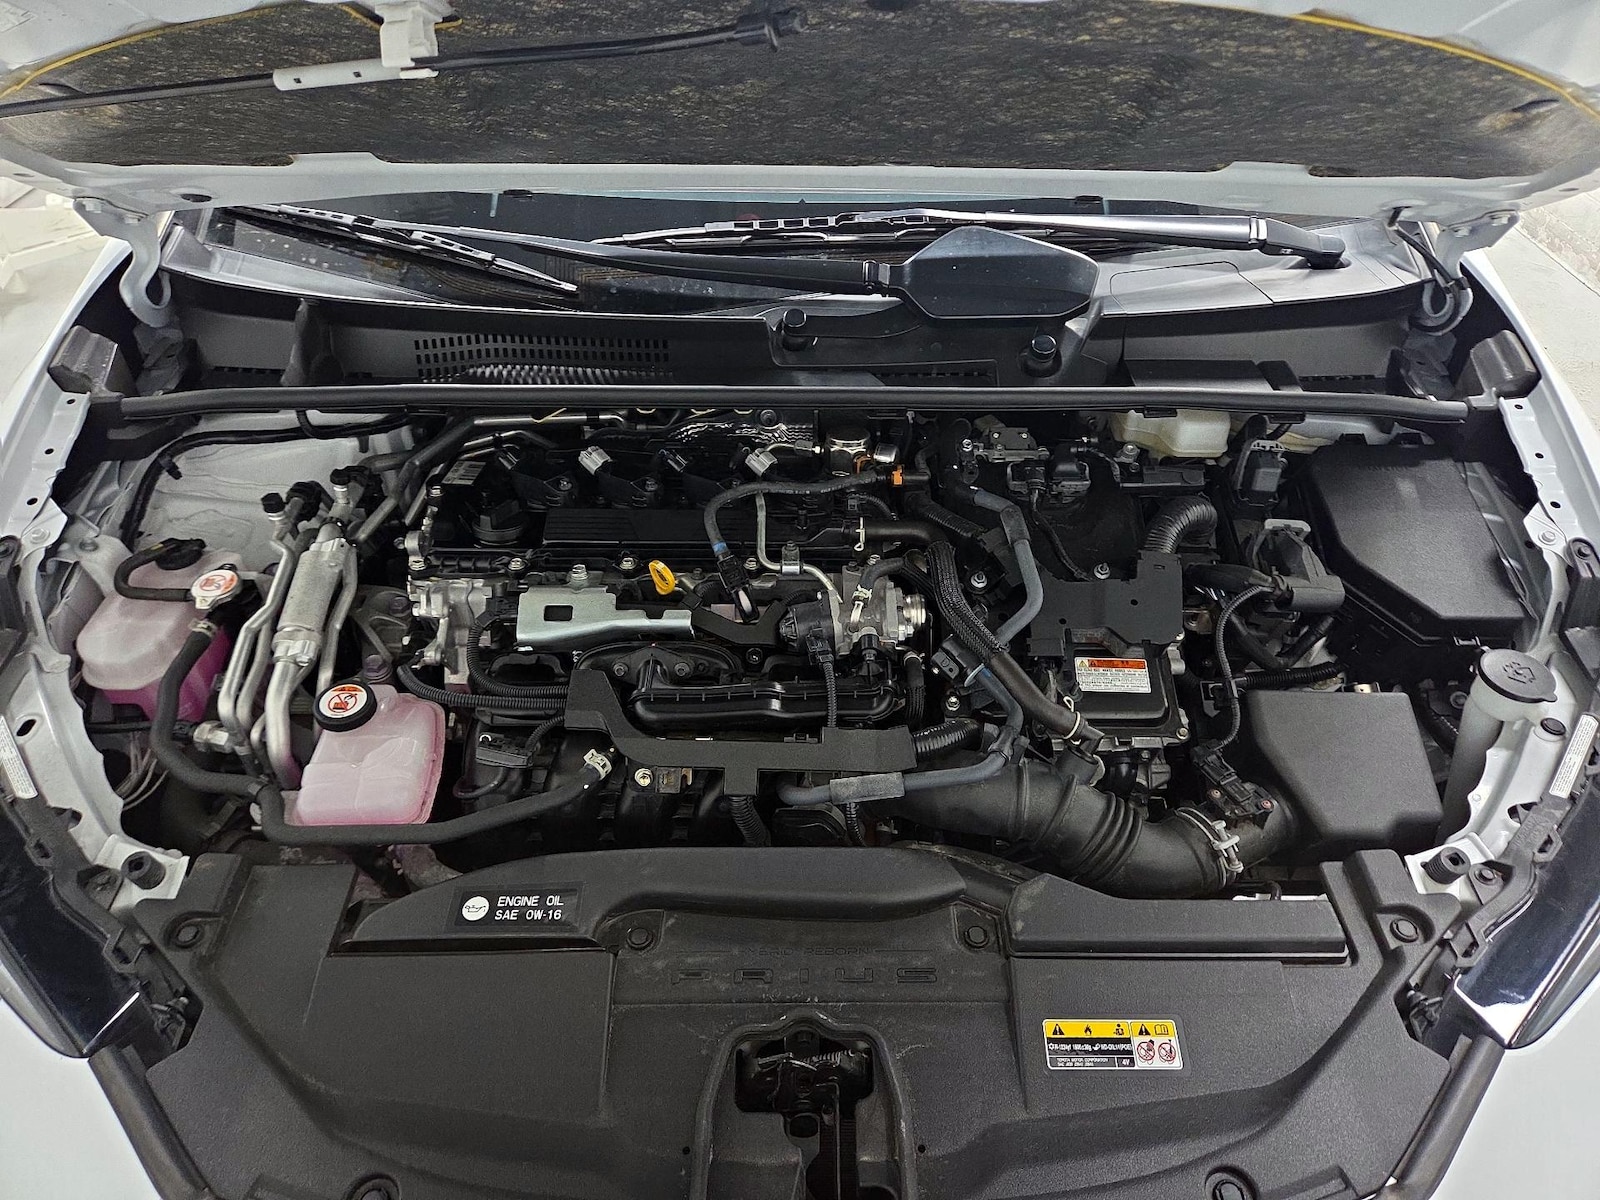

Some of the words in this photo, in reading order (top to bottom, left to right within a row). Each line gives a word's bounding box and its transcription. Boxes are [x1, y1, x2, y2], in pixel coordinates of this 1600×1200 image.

[497, 896, 540, 907] ENGINE
[546, 895, 564, 906] OIL
[494, 909, 519, 921] SAE
[525, 909, 562, 921] 0W-16
[671, 967, 938, 985] PRIUS
